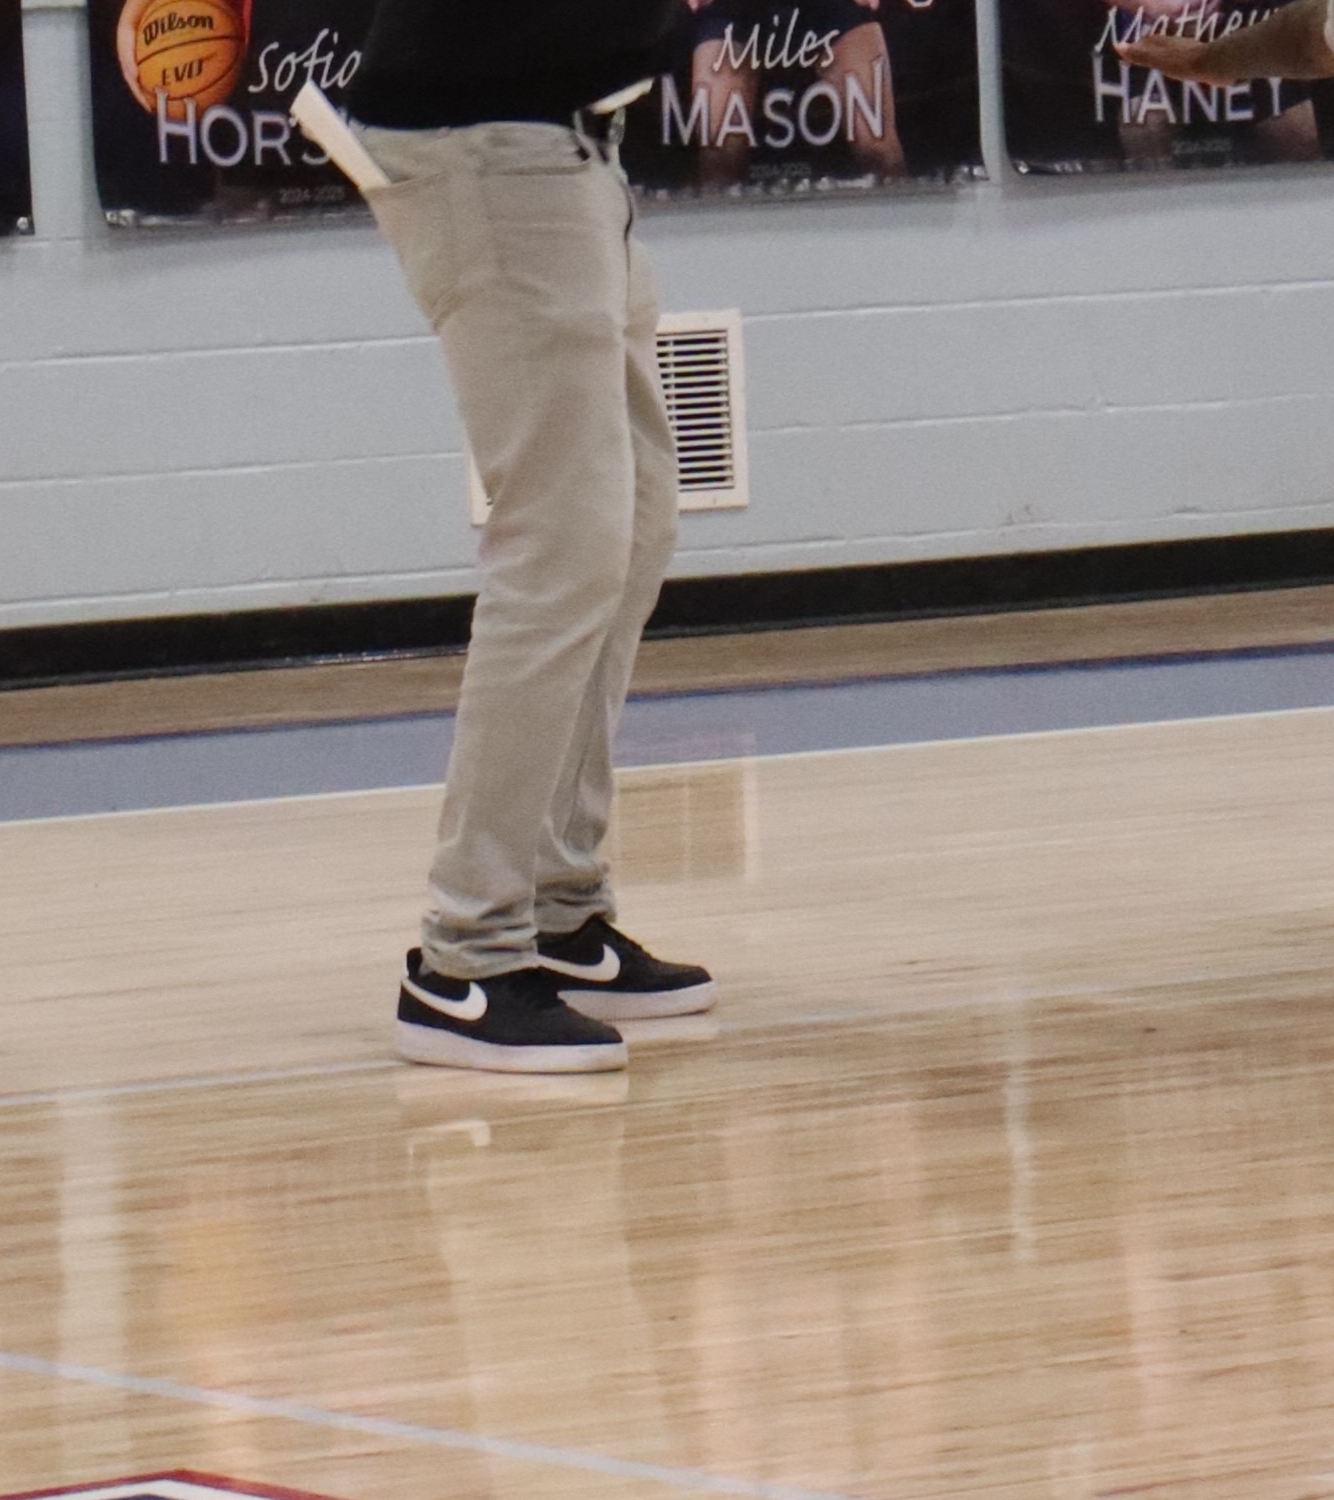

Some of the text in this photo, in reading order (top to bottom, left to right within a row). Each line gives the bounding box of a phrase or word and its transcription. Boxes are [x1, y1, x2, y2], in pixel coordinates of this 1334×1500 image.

[143, 12, 214, 45] Wilson
[712, 8, 840, 72] Miles
[662, 55, 885, 148] MASON
